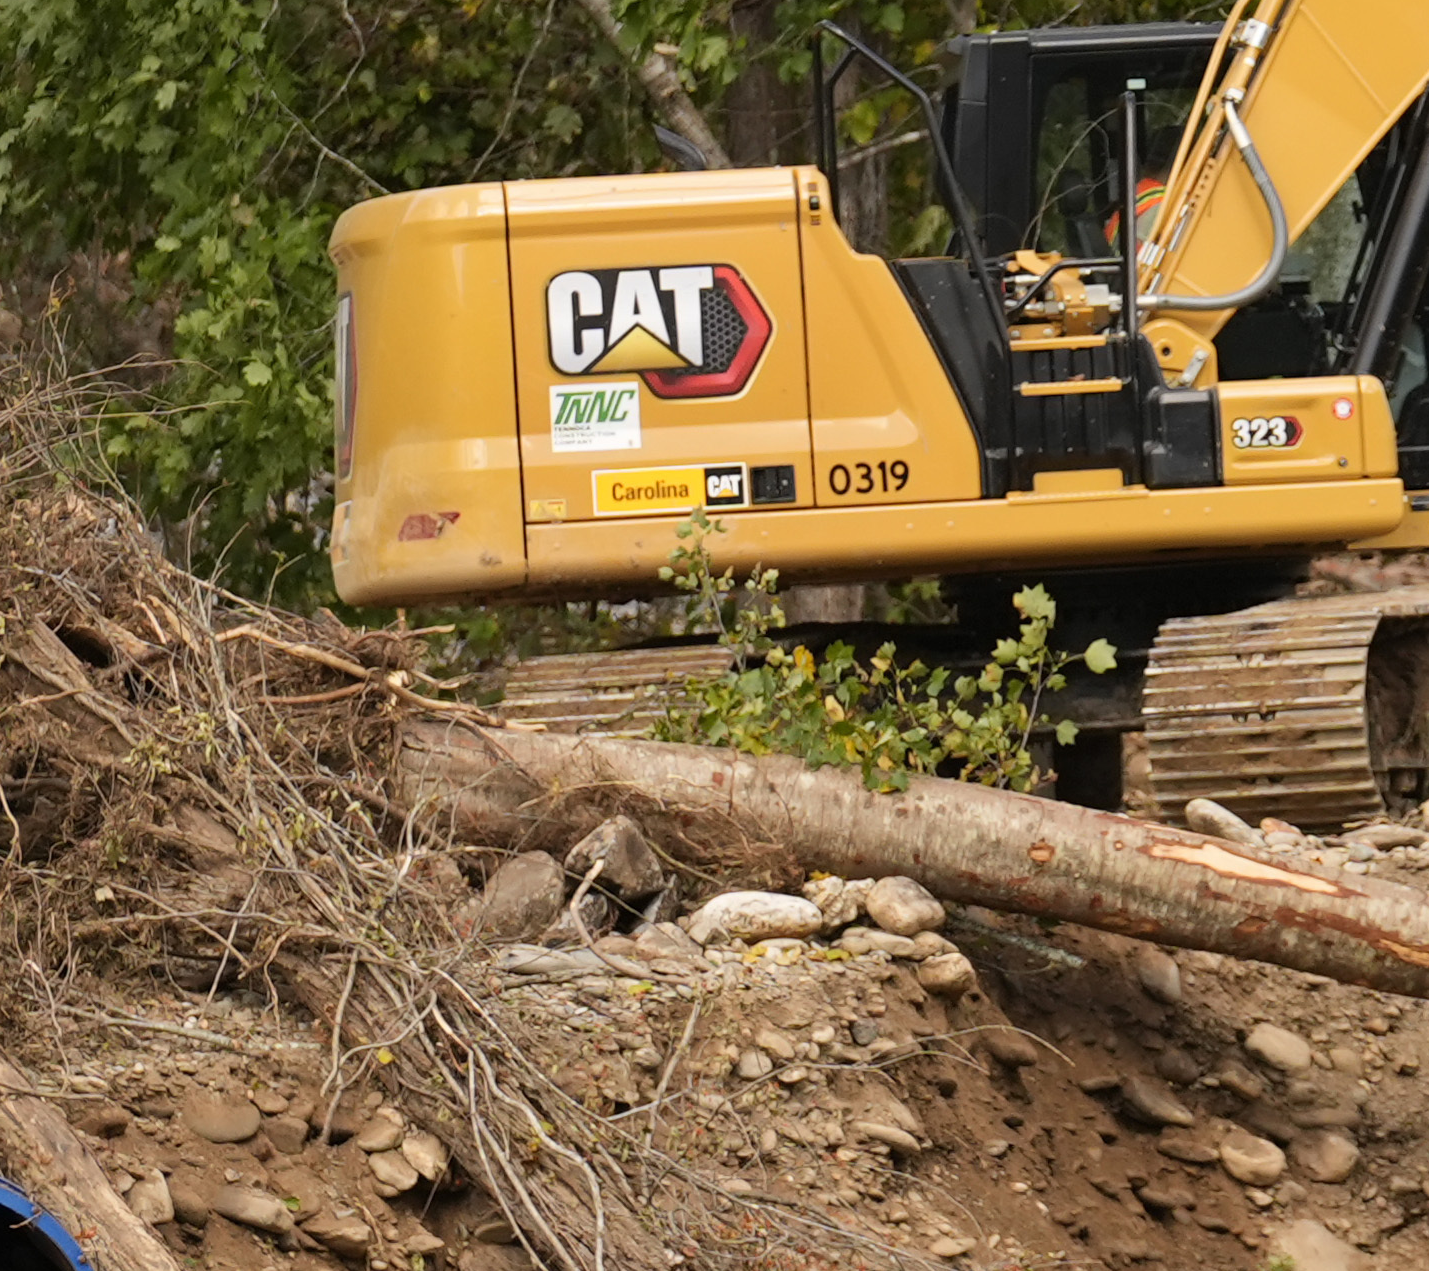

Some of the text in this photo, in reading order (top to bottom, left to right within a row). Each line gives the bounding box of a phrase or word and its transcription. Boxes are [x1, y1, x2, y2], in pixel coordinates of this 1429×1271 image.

[547, 266, 714, 374] CAT
[554, 390, 636, 425] TNNC
[1232, 417, 1288, 448] 323
[612, 474, 742, 502] Carolina CAT
[829, 460, 909, 495] 0319
